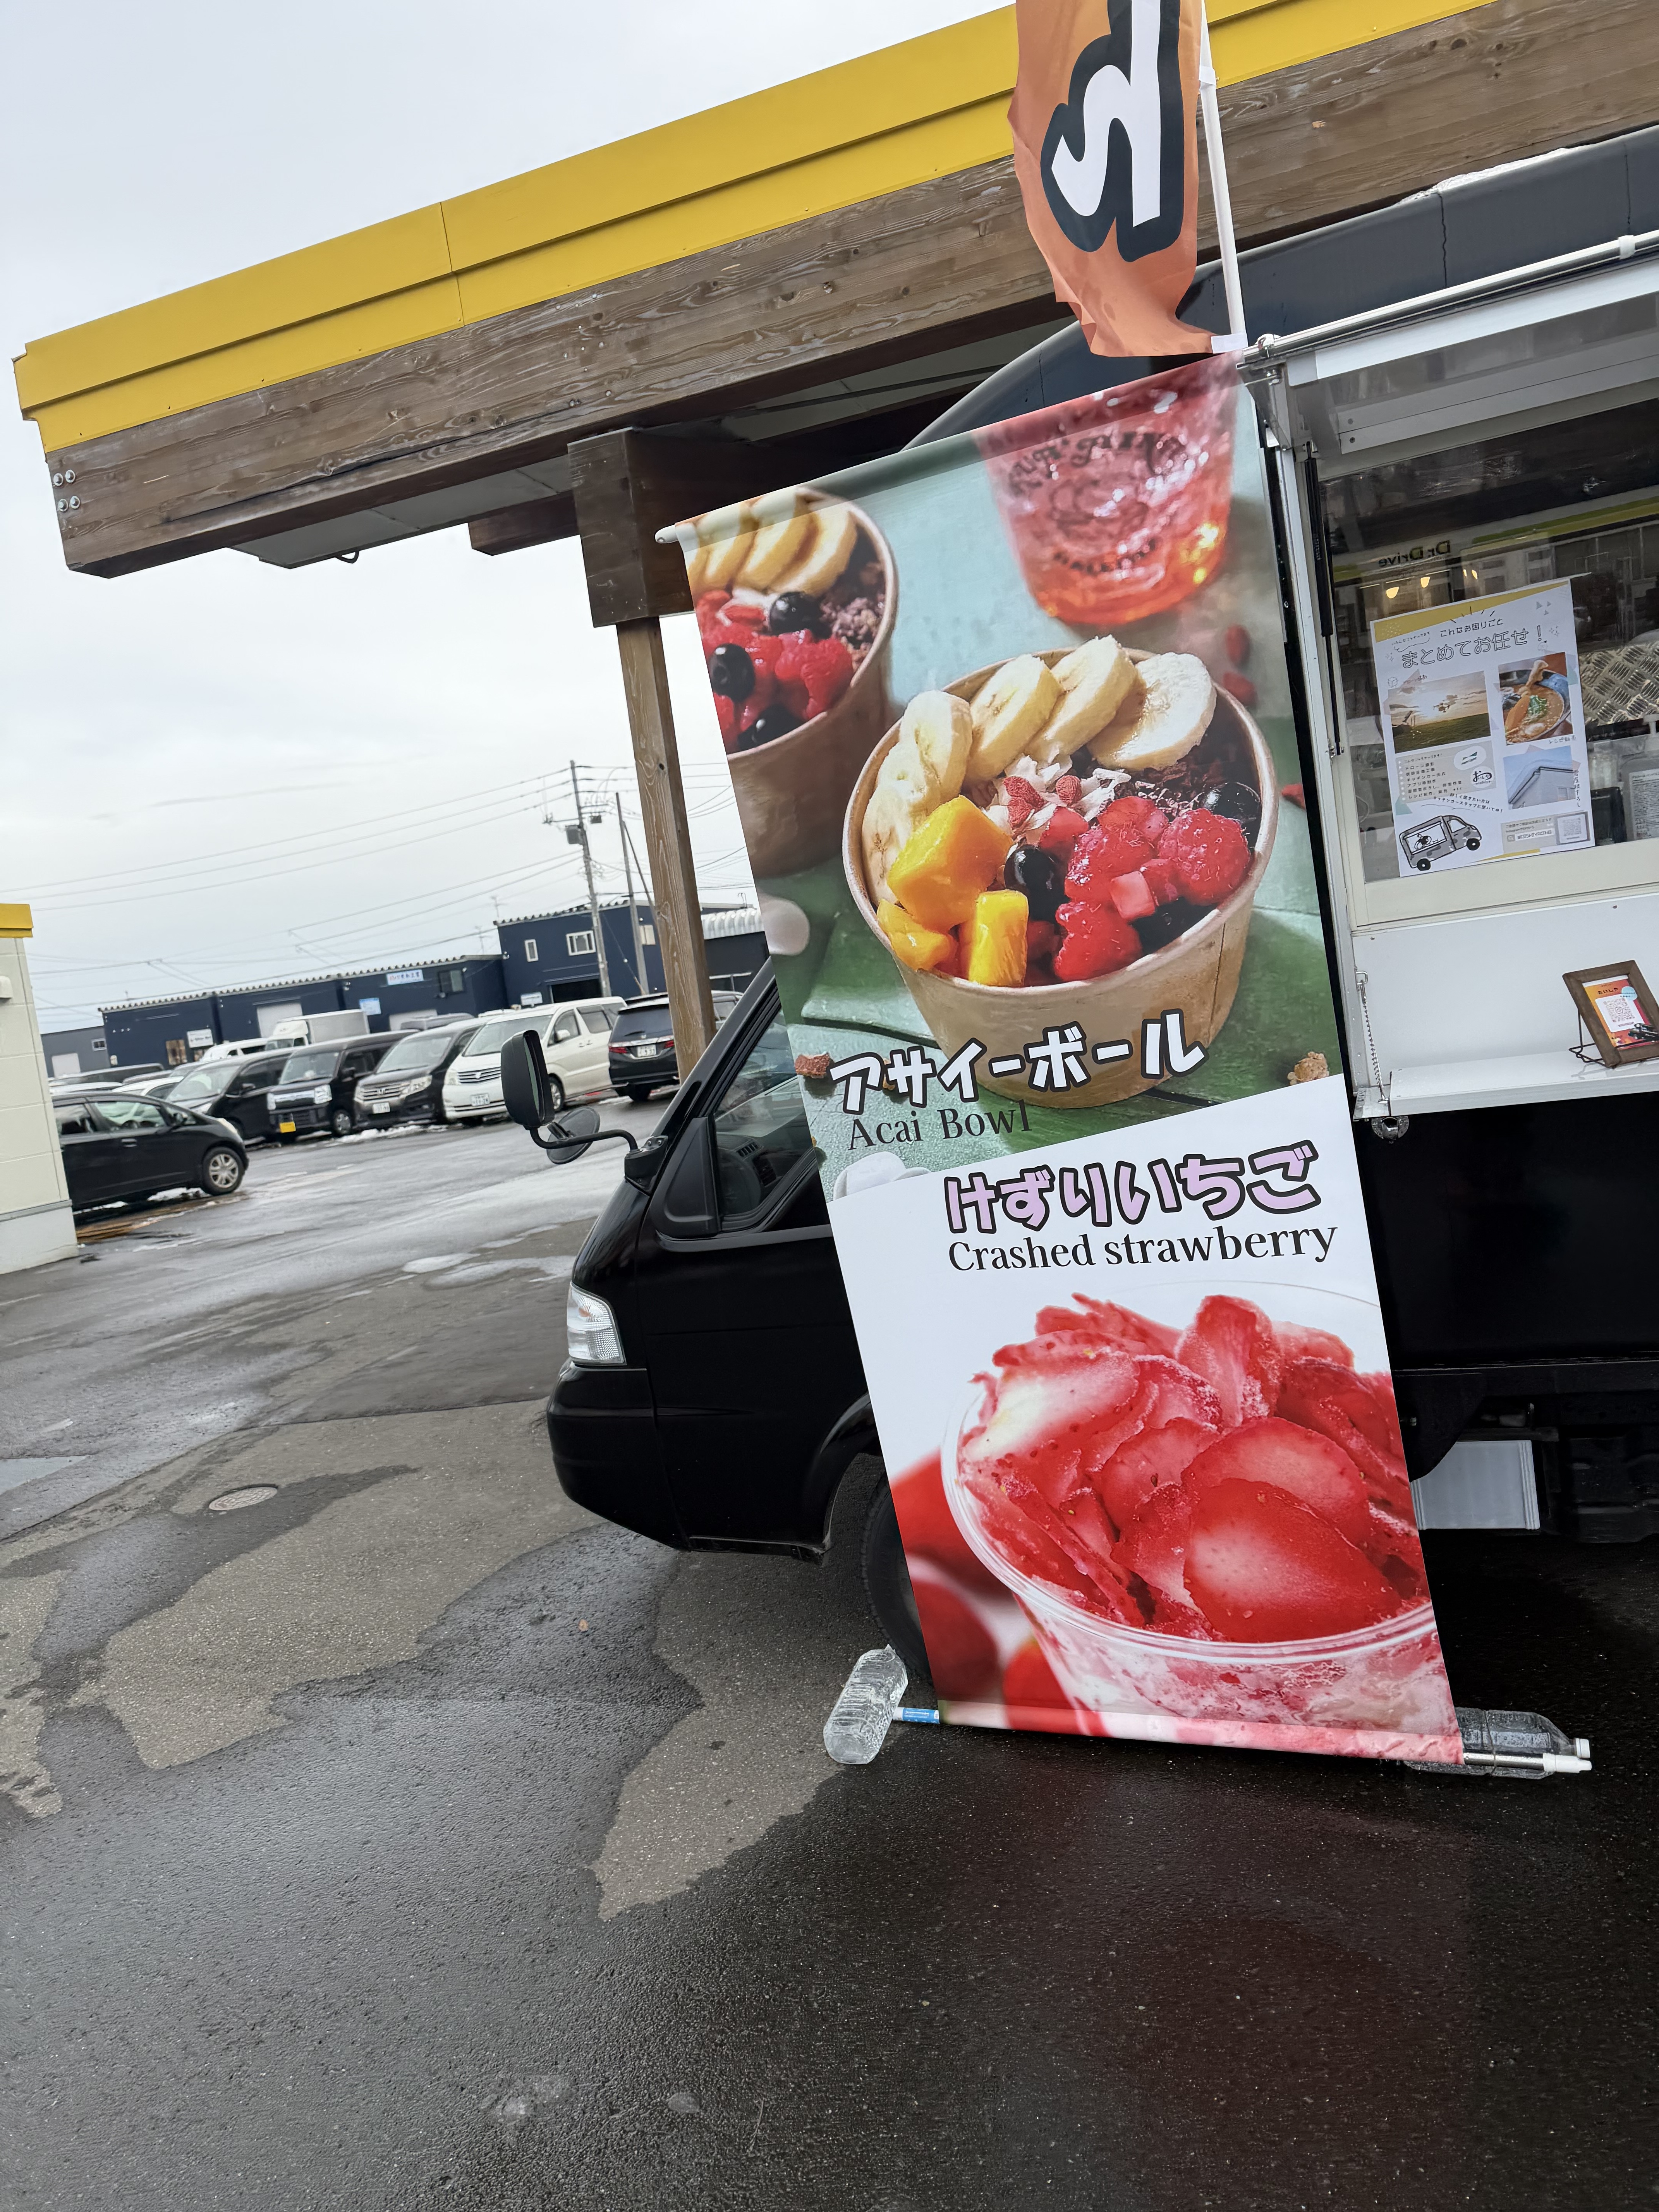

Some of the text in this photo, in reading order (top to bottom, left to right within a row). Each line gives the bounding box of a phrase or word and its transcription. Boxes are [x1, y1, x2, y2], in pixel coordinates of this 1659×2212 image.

[1401, 625, 1542, 669] まとめてお任せ！
[1440, 619, 1504, 637] こんなお困りごと
[830, 1008, 1206, 1115] アサイーボール
[847, 1100, 1033, 1151] Acai Bowl
[944, 1139, 1321, 1234] けずりいちご
[948, 1225, 1338, 1272] Crashed strawberry
